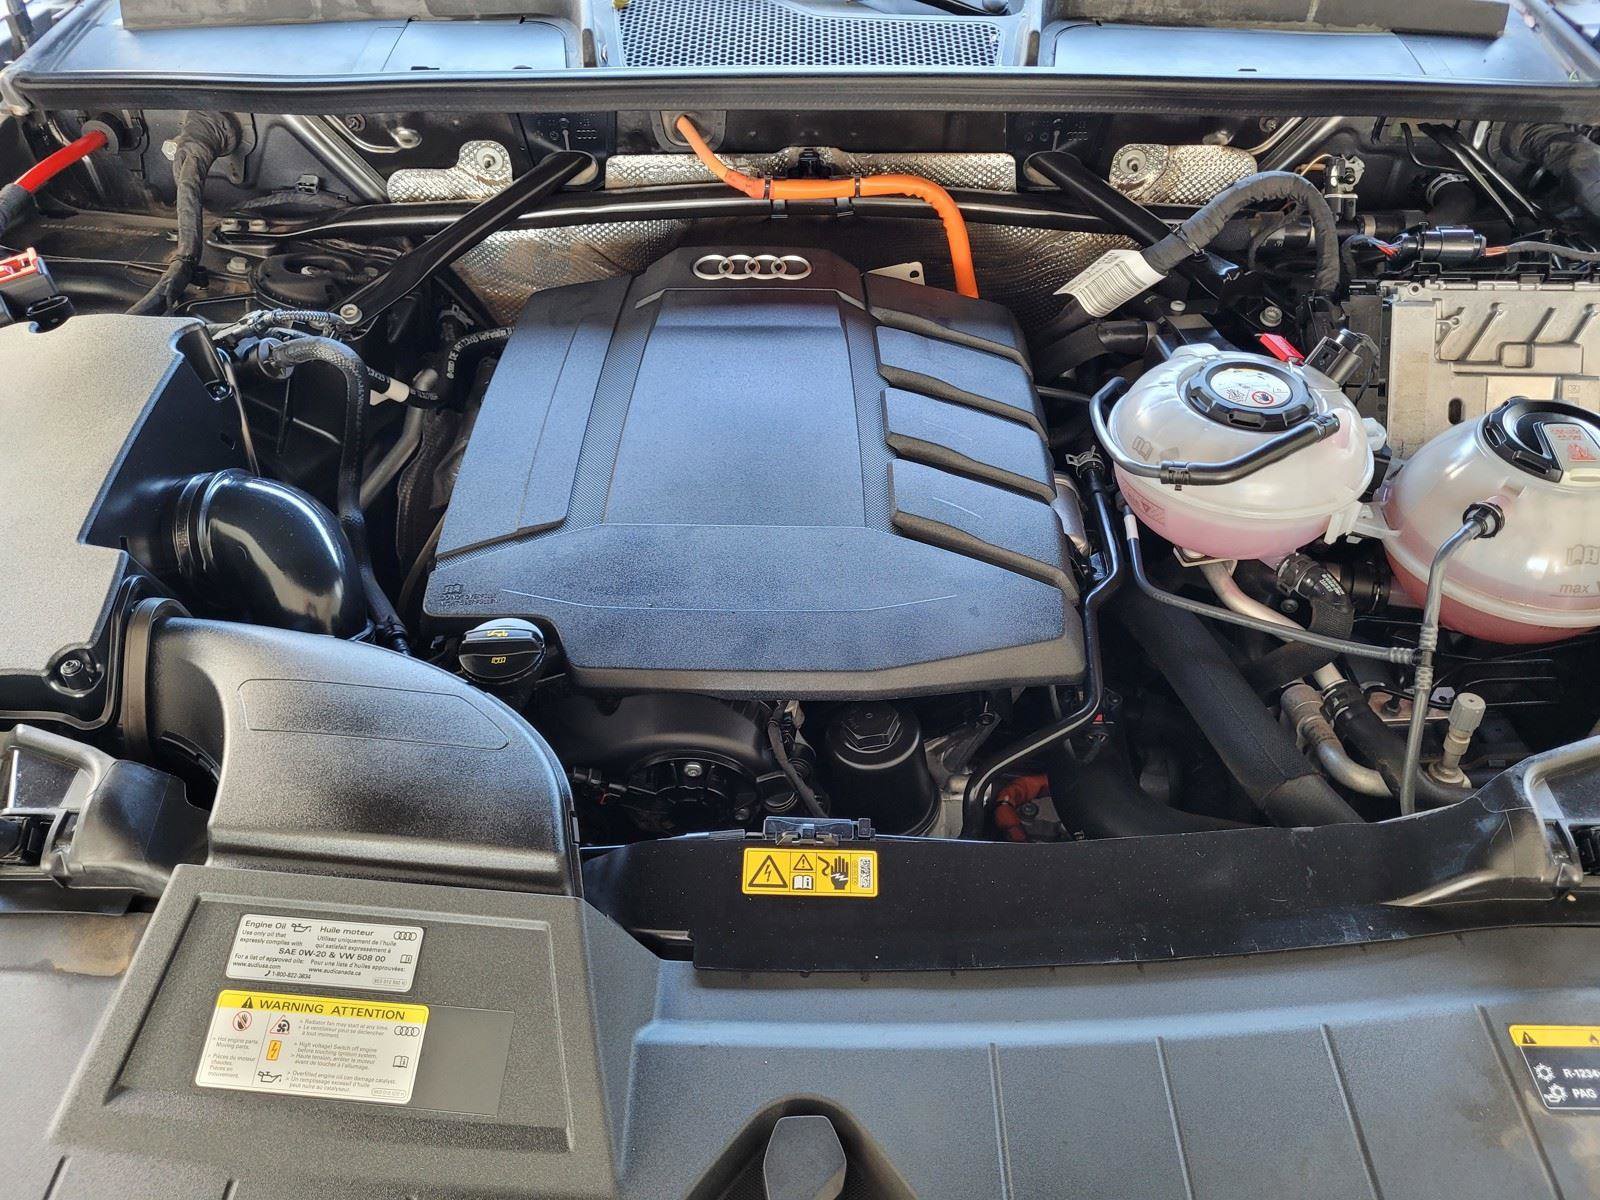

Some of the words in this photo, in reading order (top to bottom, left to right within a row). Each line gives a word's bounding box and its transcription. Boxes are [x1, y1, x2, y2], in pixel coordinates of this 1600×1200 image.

[1560, 584, 1590, 593] max
[245, 920, 272, 929] Engine
[298, 949, 327, 958] 0W-20
[308, 967, 361, 976] www.audicanada.ca
[260, 999, 324, 1014] WARNING
[330, 1006, 405, 1021] ATTENTION
[1571, 1088, 1597, 1099] PAG
